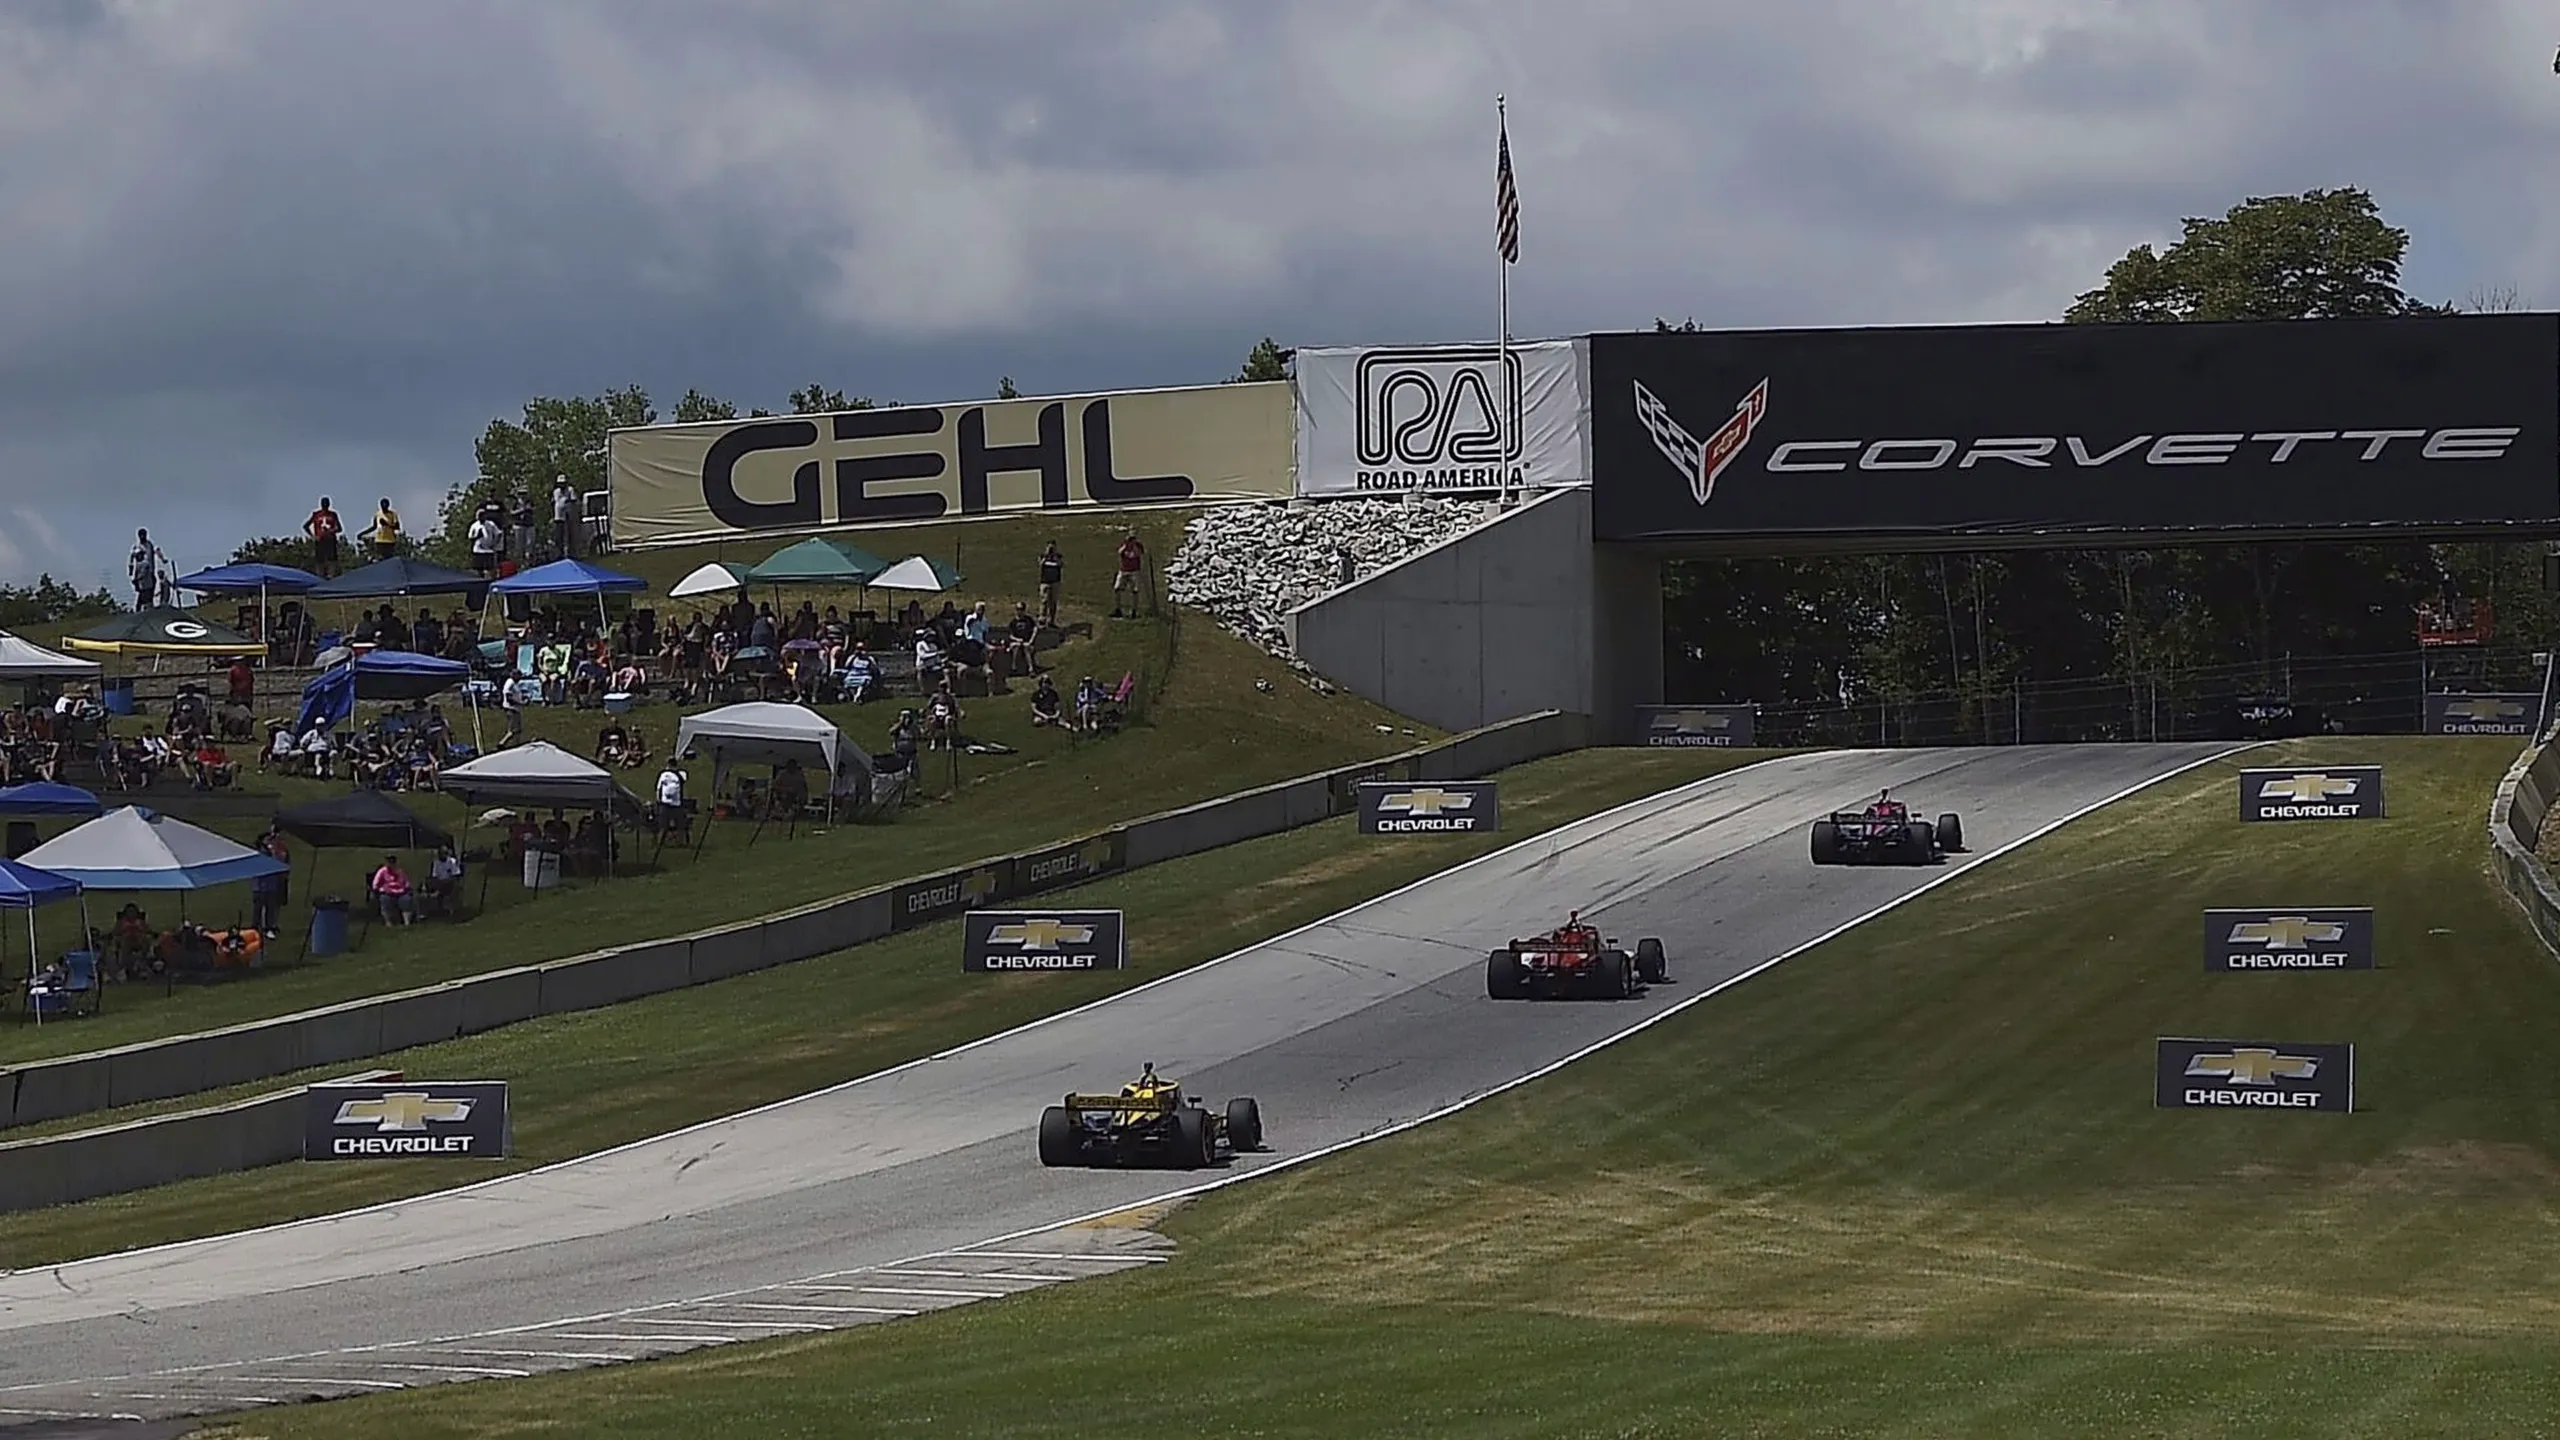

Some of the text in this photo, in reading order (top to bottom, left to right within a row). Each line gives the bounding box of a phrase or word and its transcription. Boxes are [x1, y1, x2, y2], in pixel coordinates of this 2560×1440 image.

[1765, 426, 2522, 472] CORVETTE
[702, 398, 1194, 528] GEHL
[1356, 471, 1417, 490] ROAD
[2443, 723, 2527, 733] CHEVROLET
[1649, 736, 1731, 746] CHEVROLET
[2260, 804, 2360, 818] CHEVROLET
[1378, 818, 1475, 831] CHEVROLET
[986, 954, 1097, 970] CHEVROLET
[2228, 953, 2348, 968] CHEVROLET
[2185, 1089, 2320, 1107] CHEVROLET
[334, 1136, 474, 1154] CHEVROLET
